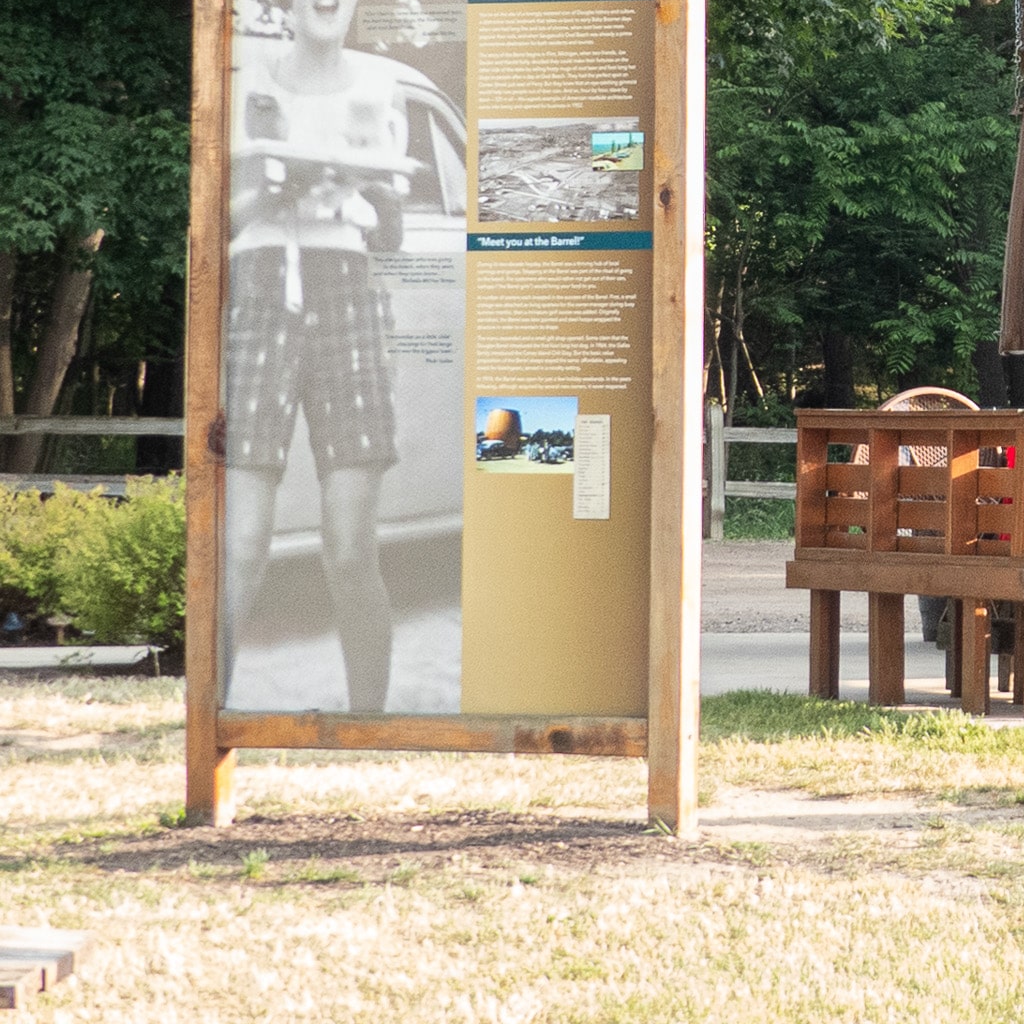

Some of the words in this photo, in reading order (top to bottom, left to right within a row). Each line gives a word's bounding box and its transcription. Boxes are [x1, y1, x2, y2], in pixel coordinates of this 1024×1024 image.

[505, 239, 523, 249] you
[524, 237, 533, 246] at
[534, 236, 549, 246] the
